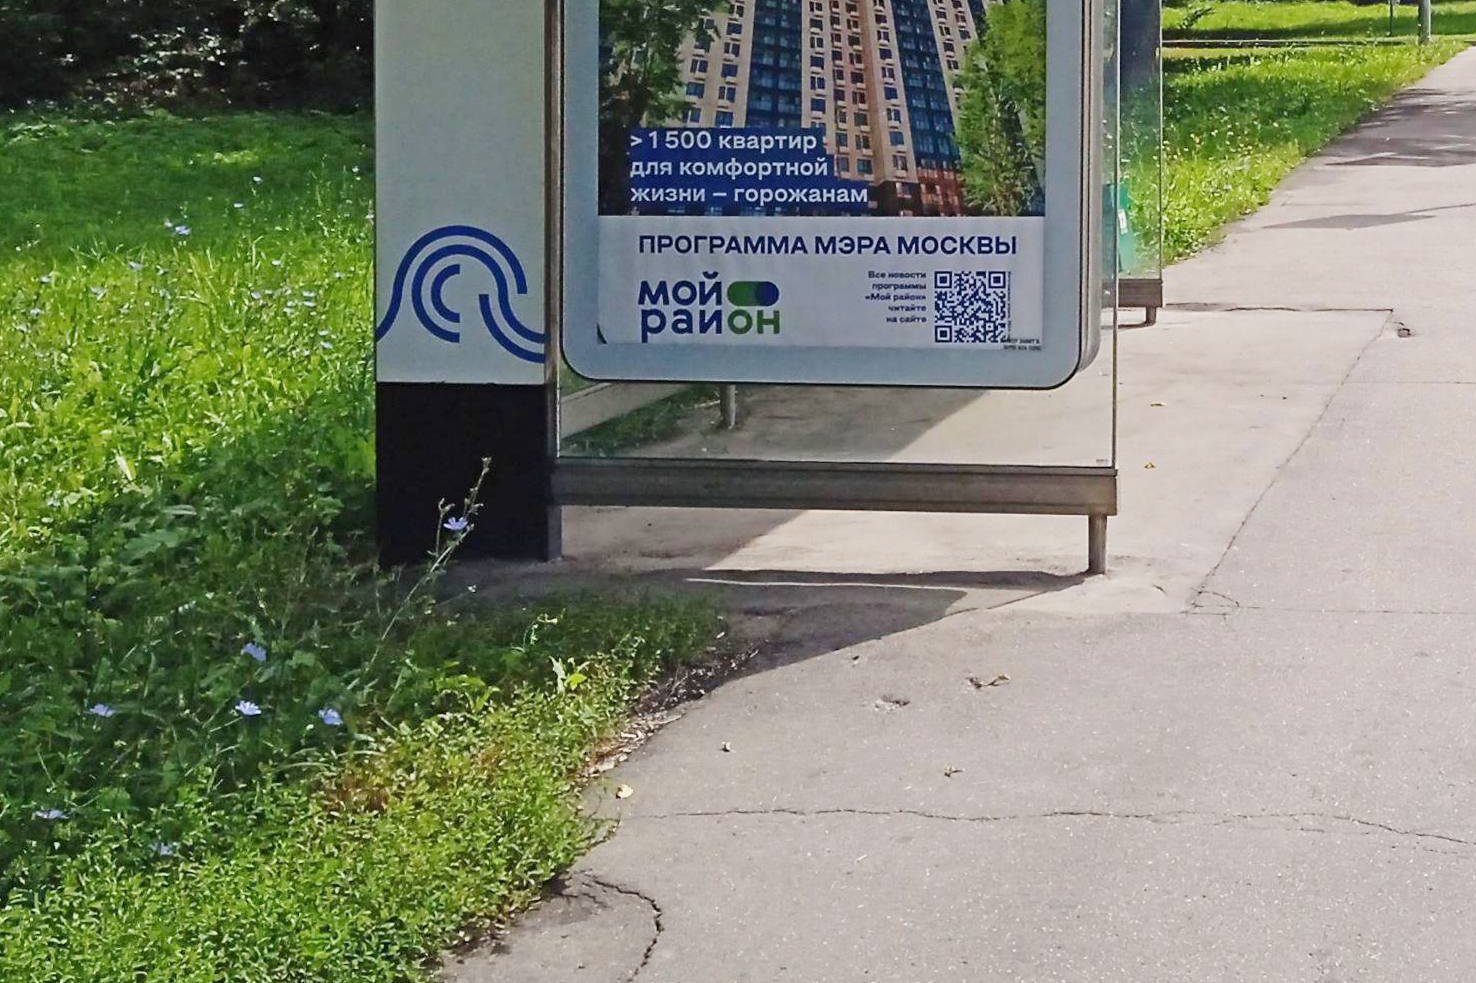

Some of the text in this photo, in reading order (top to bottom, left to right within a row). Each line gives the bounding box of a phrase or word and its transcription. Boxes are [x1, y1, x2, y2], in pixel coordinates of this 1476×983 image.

[719, 134, 817, 155] квартир
[630, 157, 828, 180] для комфортной
[631, 187, 705, 203] жизни
[734, 187, 868, 206] горожанам
[639, 235, 1017, 255] ПРОГРАММА МЭРА МОСКВЫ
[868, 270, 886, 279] Все
[638, 271, 722, 306] мой
[872, 283, 927, 291] программы
[899, 315, 927, 323] сайте
